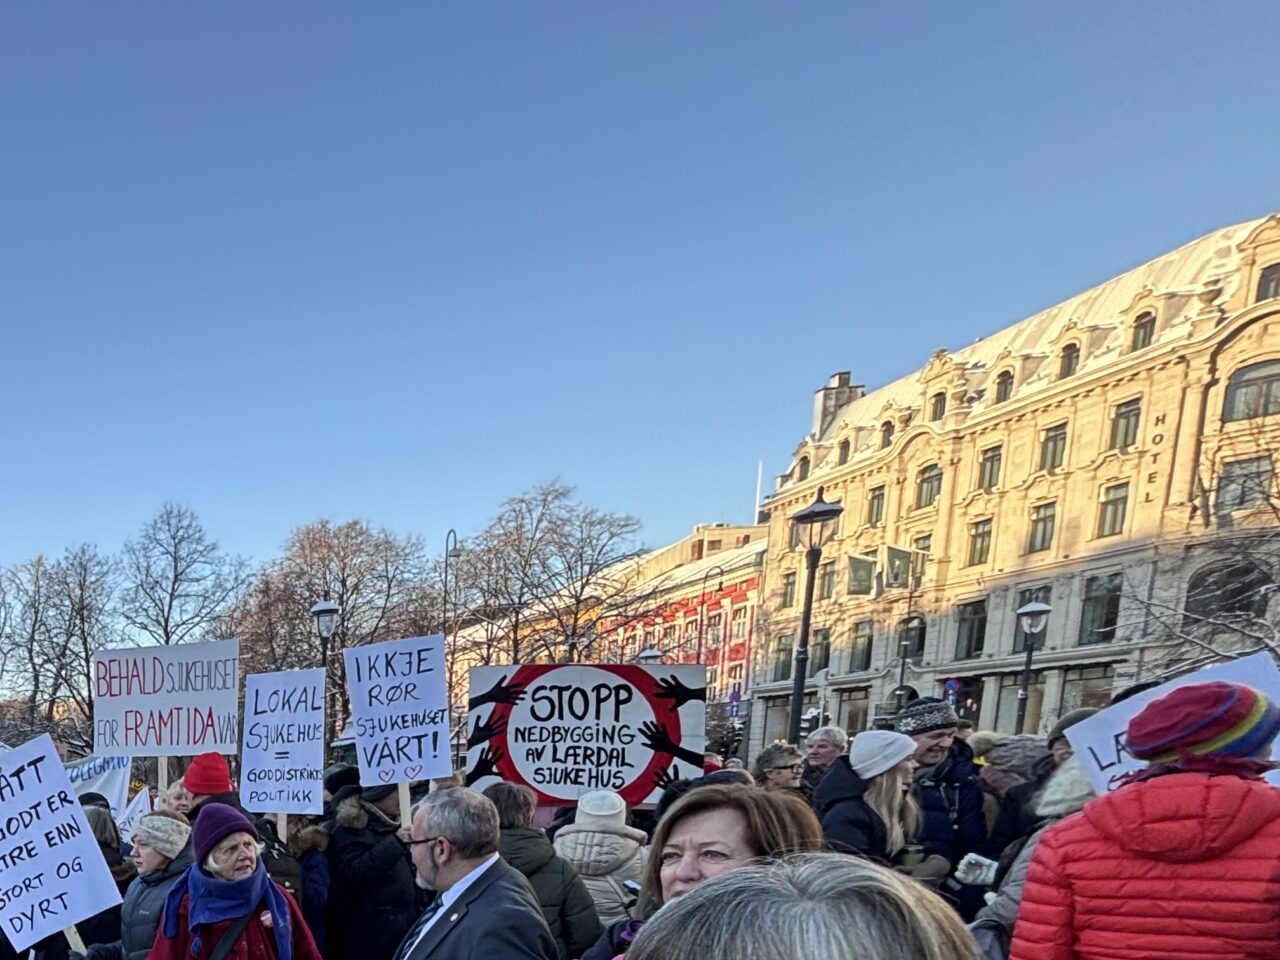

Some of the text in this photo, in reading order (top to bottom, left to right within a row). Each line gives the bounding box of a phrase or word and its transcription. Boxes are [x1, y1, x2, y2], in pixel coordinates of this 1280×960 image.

[1144, 412, 1167, 503] HOTEL
[96, 656, 237, 697] BEHALD SJUKEHUSET
[355, 648, 434, 683] IKKJE
[368, 681, 420, 707] RØR
[530, 683, 633, 723] STOPP
[97, 719, 120, 747] FOR
[124, 706, 218, 747] FRAMTIDA
[246, 722, 322, 752] SJUKEHUS
[356, 708, 447, 738] SJUKEHUSET
[363, 730, 439, 769] VÅRT!
[525, 743, 635, 769] AV LÆRDAL
[532, 766, 625, 790] SJUKEHUS
[44, 814, 82, 849] ENN
[56, 856, 84, 880] OG
[8, 892, 70, 934] DYRT
